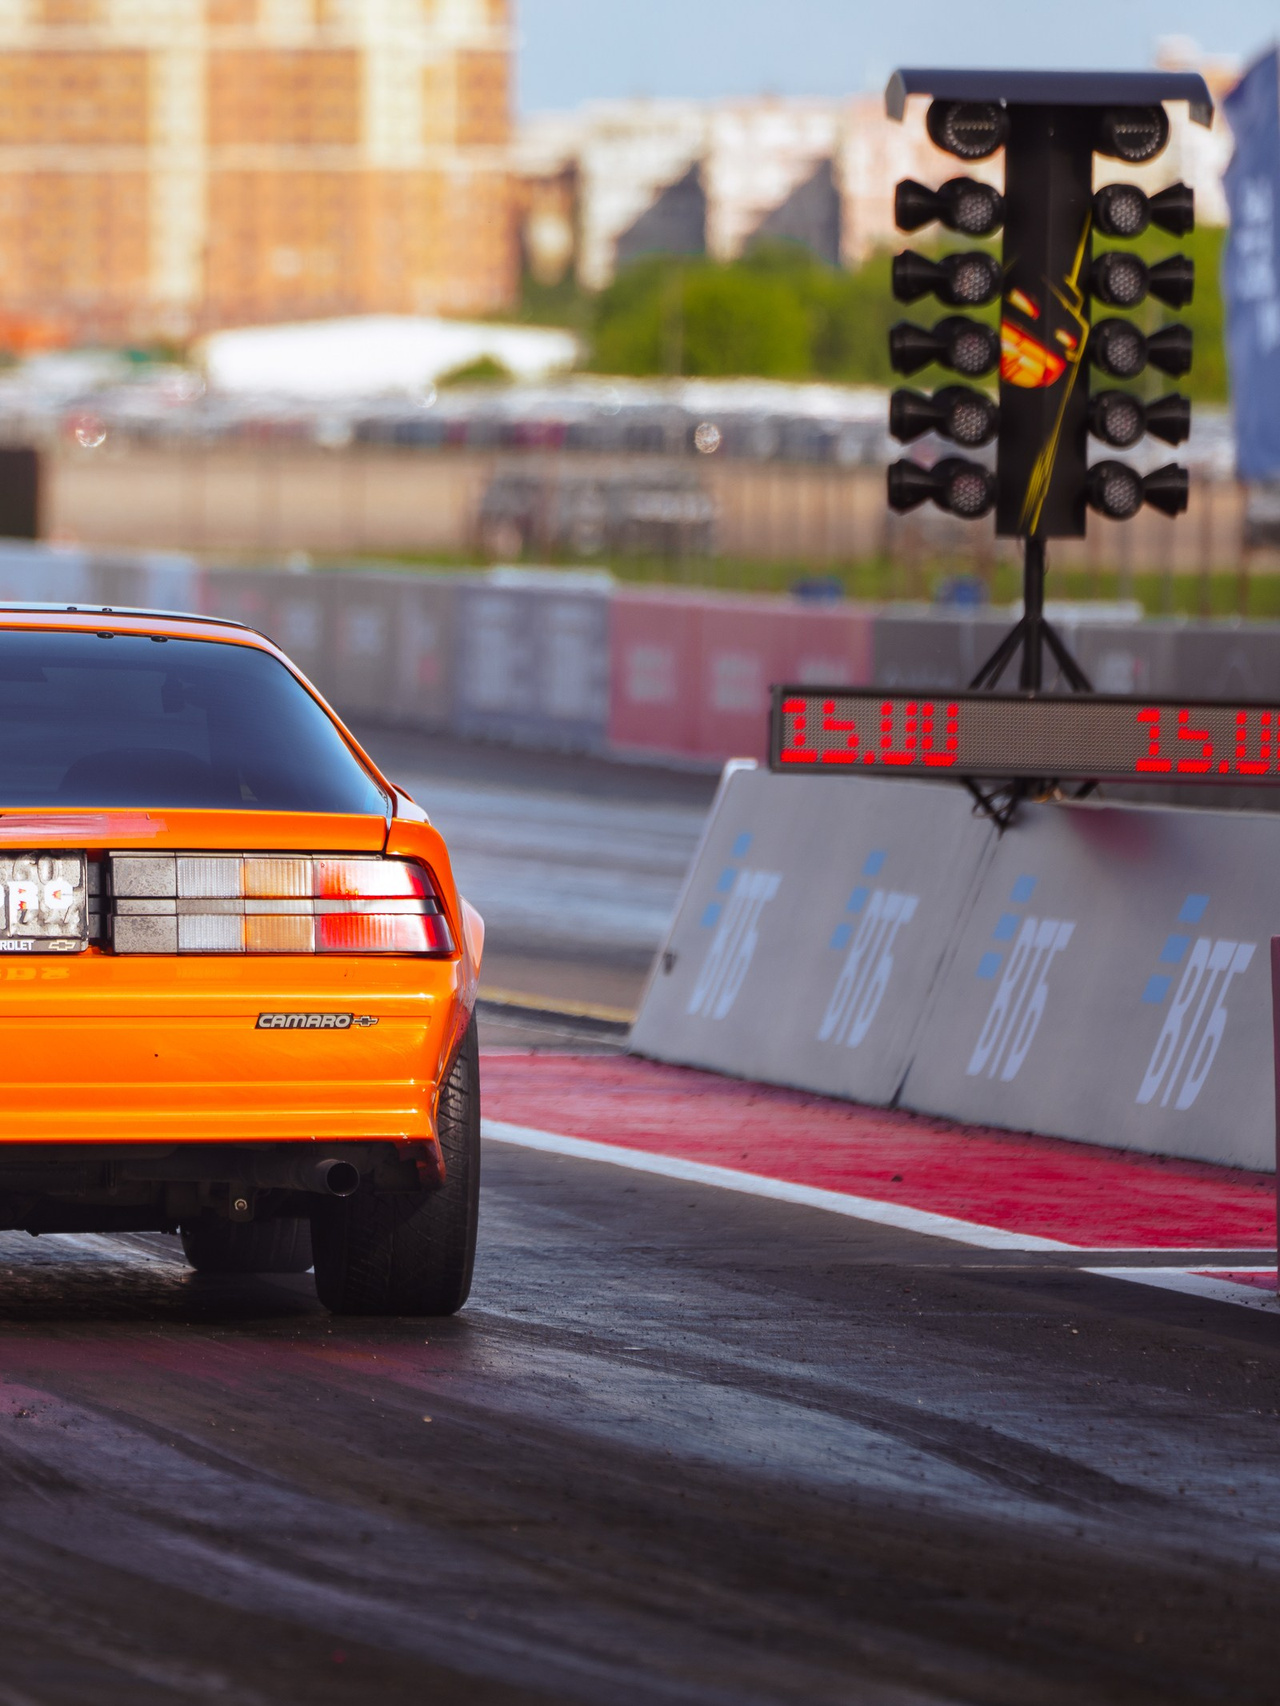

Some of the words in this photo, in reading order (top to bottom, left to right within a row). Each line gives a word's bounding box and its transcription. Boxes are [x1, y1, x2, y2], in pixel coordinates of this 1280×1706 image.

[780, 698, 959, 766] 15.00
[1135, 708, 1280, 774] 15.0
[258, 1014, 351, 1028] CAMARO
